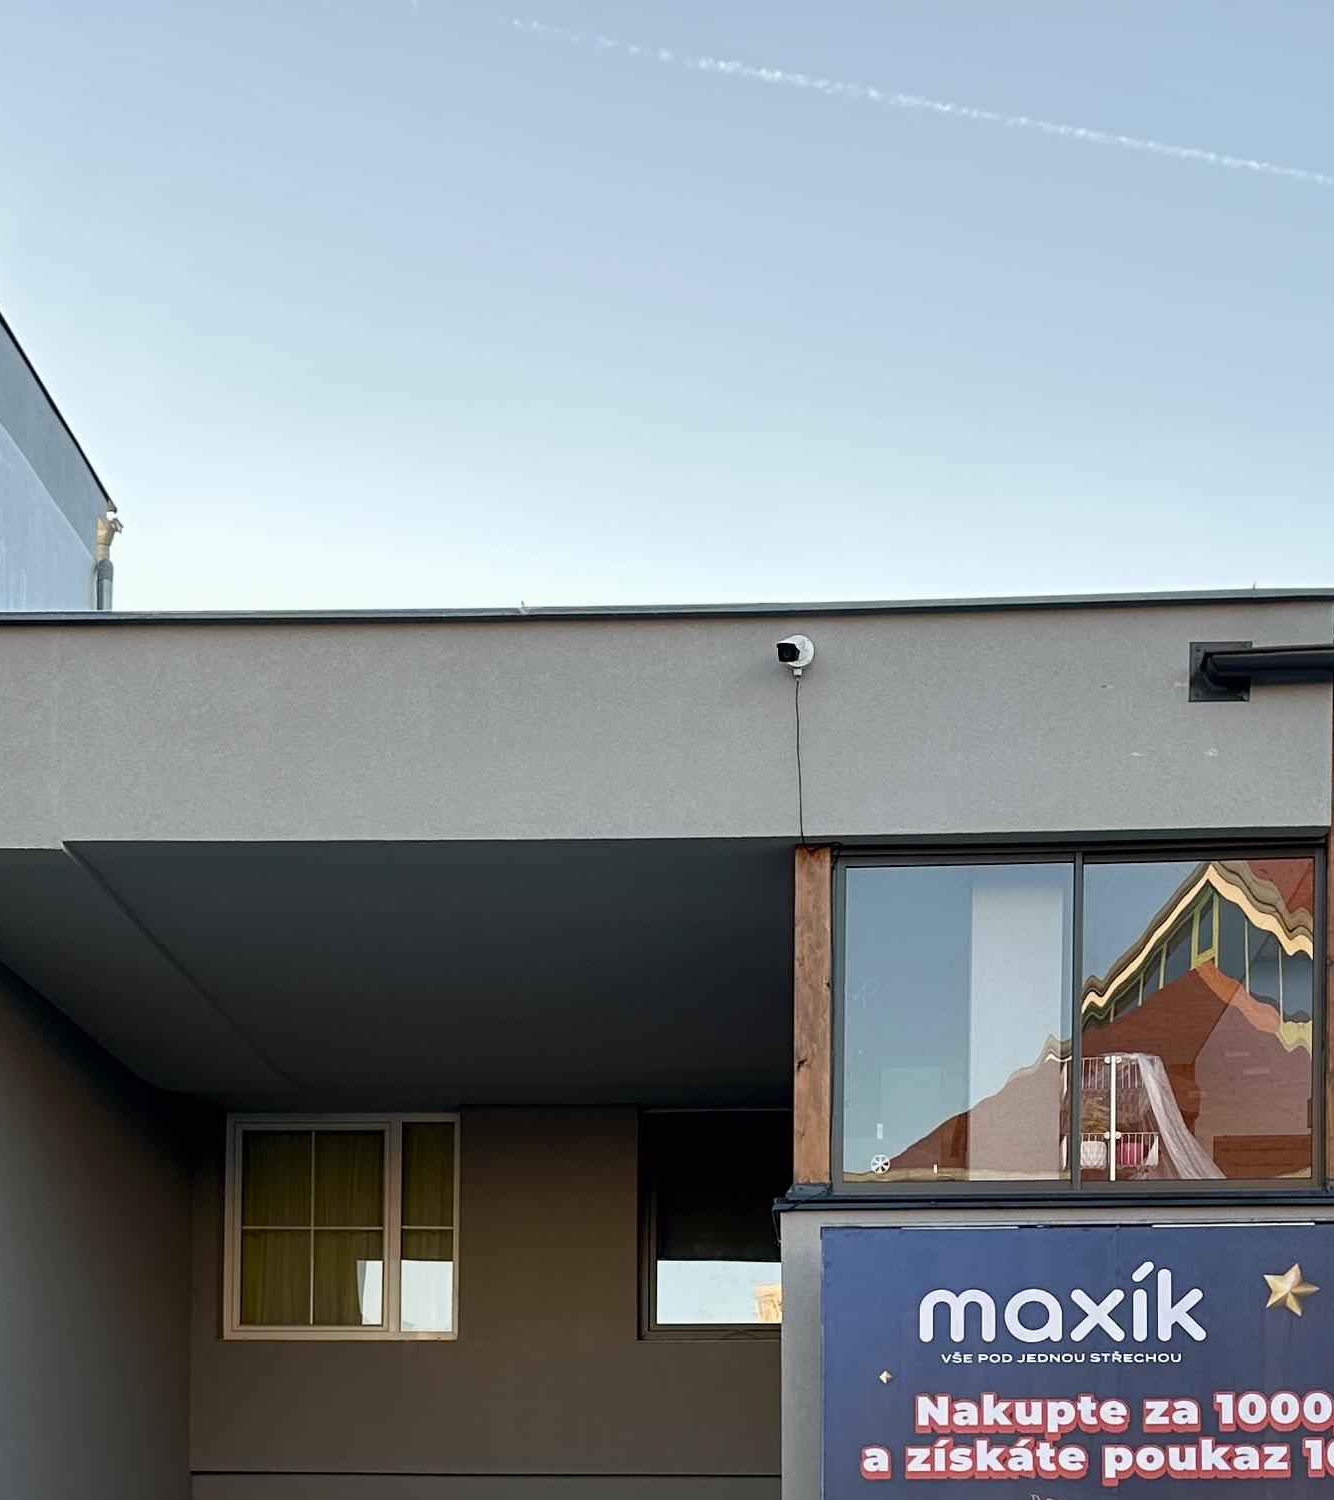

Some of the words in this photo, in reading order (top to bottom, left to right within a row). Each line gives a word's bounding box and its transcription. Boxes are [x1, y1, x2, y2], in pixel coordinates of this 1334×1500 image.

[919, 1261, 1207, 1343] maxík
[941, 1351, 973, 1363] VŠE
[978, 1353, 1013, 1363] POD
[1017, 1353, 1086, 1363] JEDNOU
[1090, 1351, 1182, 1363] STŘECHOU
[916, 1393, 1129, 1434] Nakupte
[1144, 1397, 1200, 1428] za
[862, 1446, 891, 1476] a
[906, 1437, 1088, 1476] získáte
[1103, 1440, 1291, 1482] poukaz
